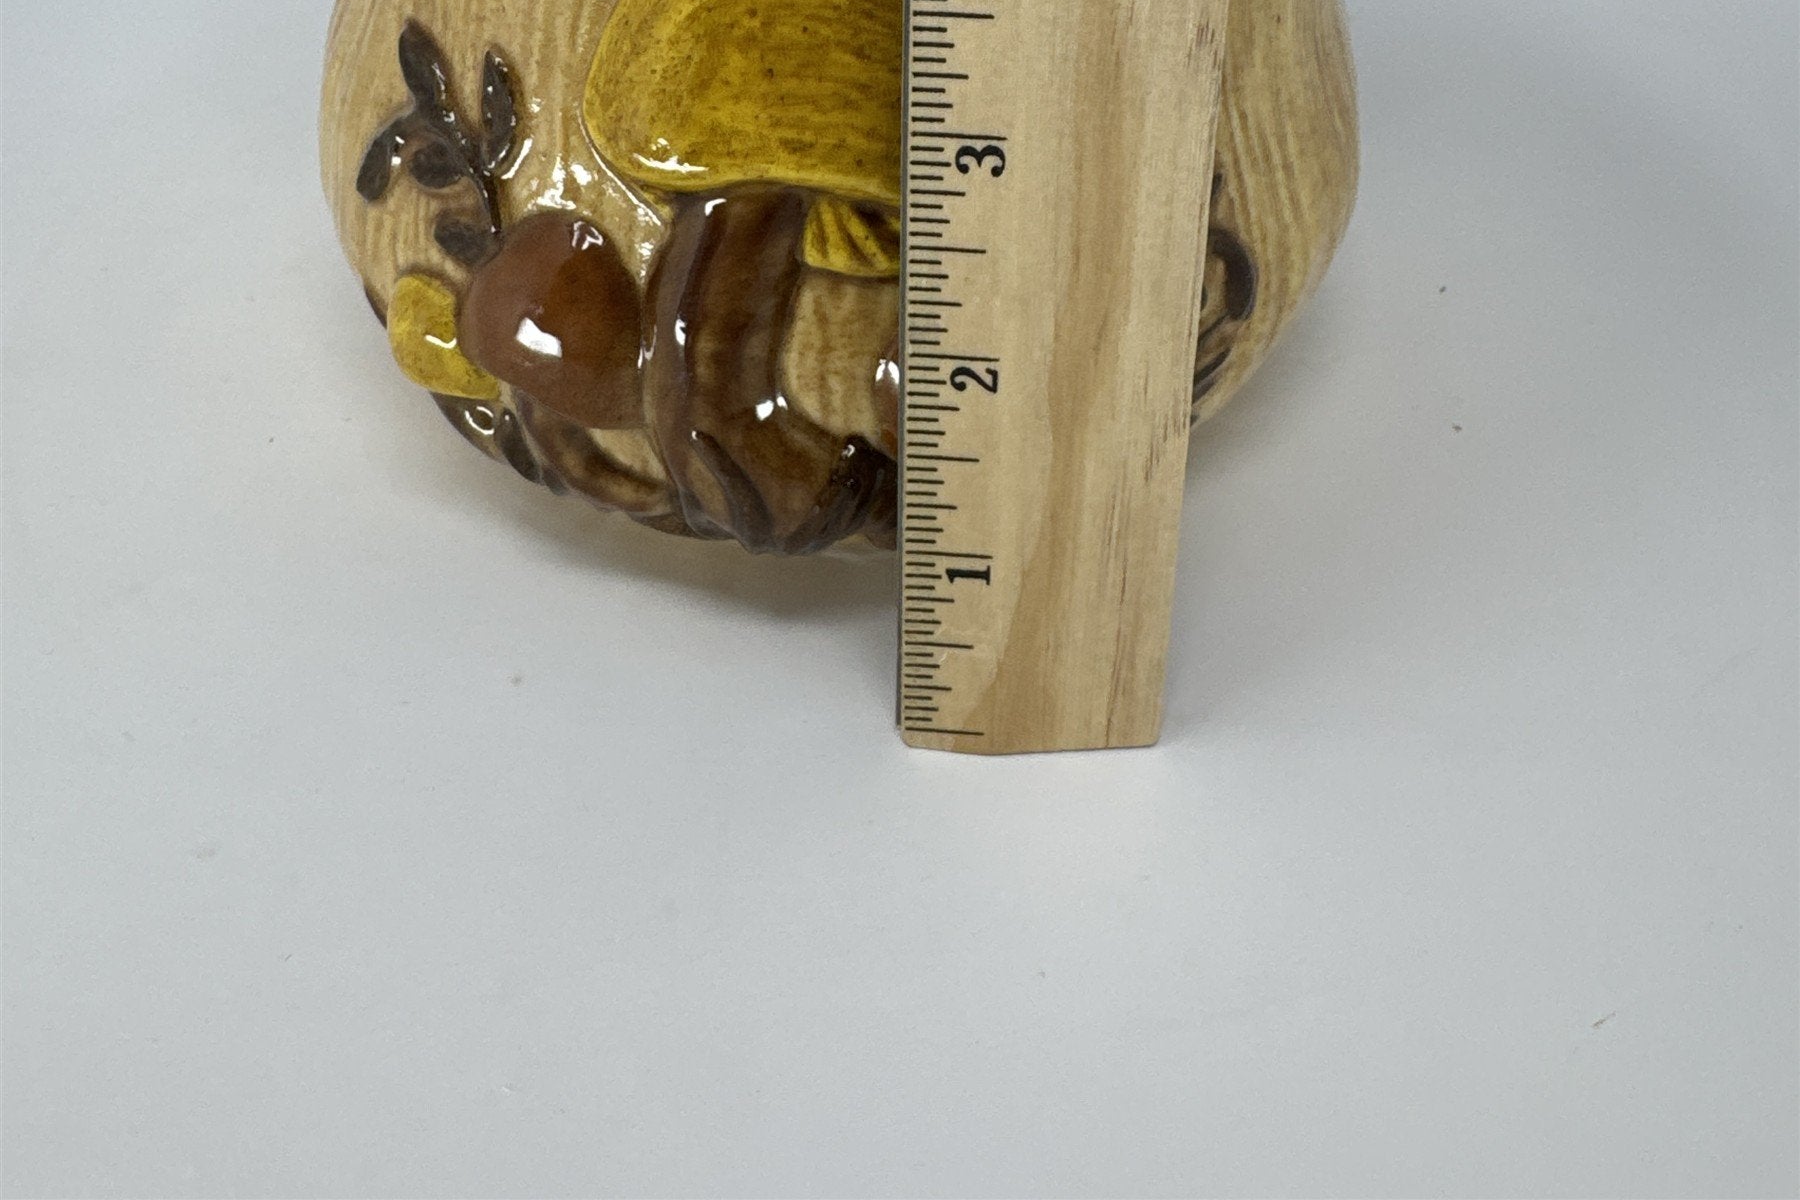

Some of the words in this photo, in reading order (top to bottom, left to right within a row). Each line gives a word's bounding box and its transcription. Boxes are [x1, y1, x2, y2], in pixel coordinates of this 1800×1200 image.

[955, 144, 1007, 178] 3
[949, 366, 1000, 395] 2
[945, 564, 992, 586] 1
